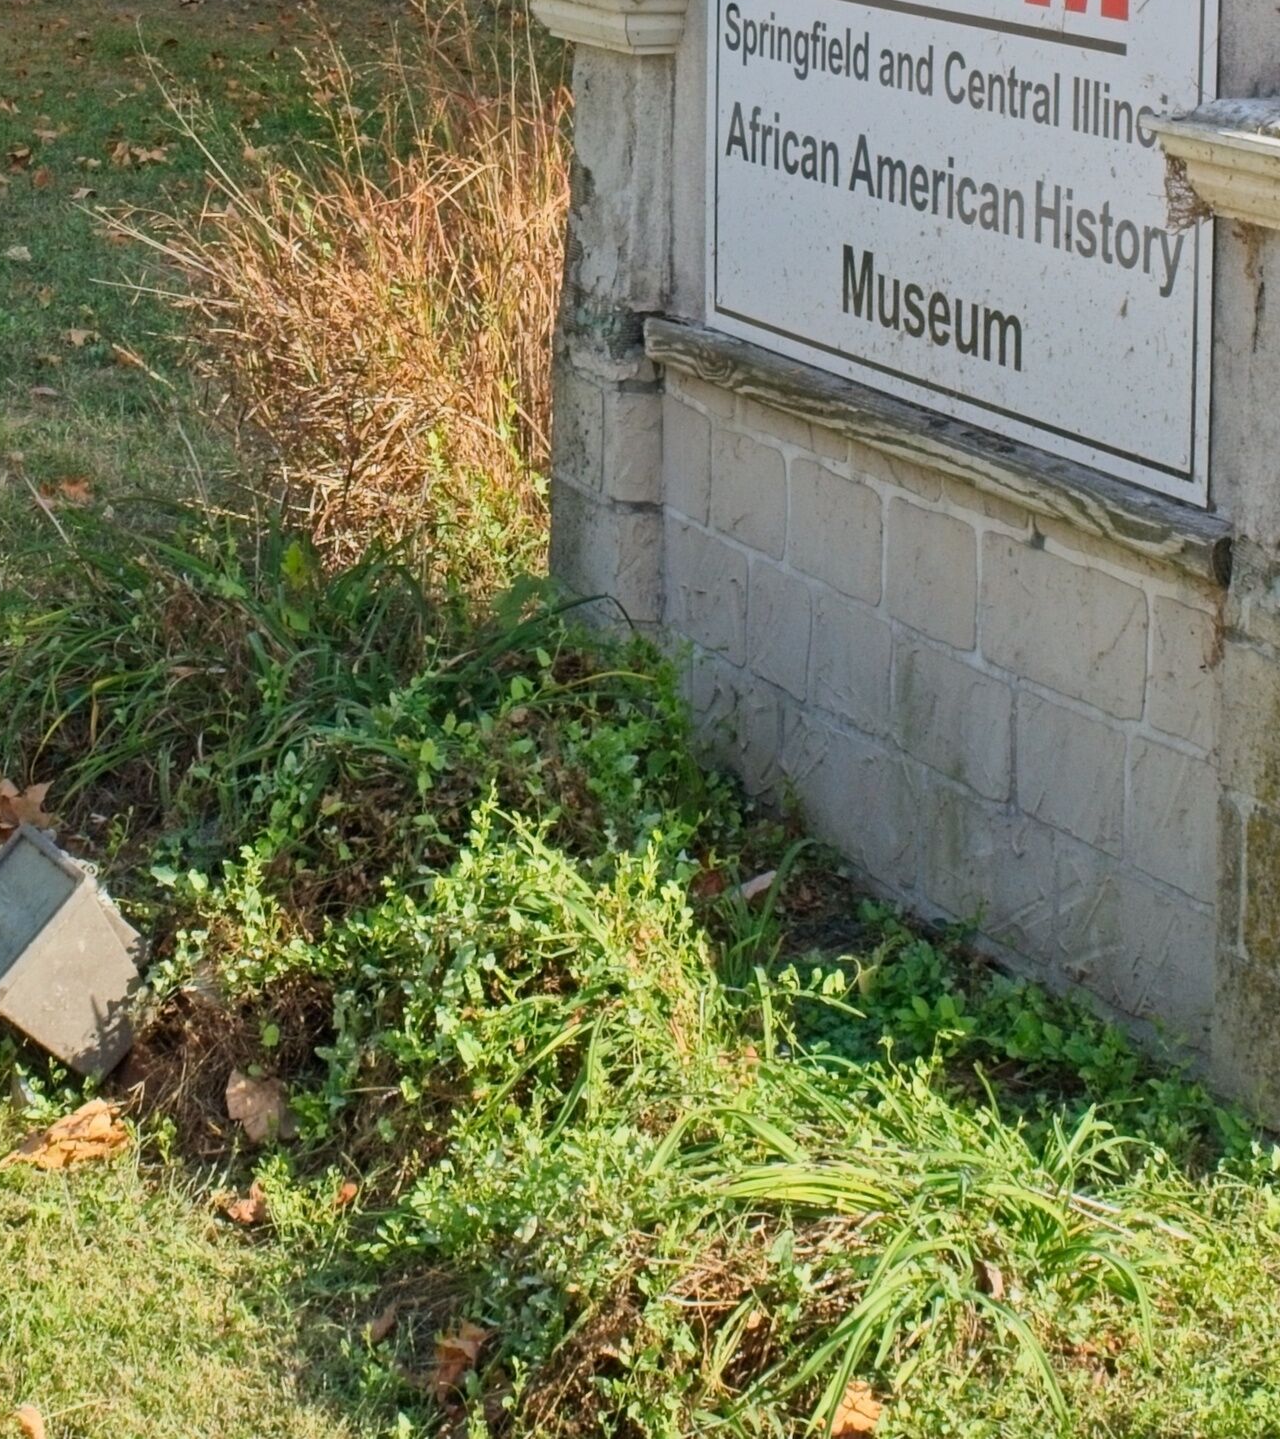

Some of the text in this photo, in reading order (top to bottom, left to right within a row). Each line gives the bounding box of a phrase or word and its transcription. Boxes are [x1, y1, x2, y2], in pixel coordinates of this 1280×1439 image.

[725, 2, 1168, 148] Springfield and Central Illino
[725, 101, 1185, 298] African American History
[842, 243, 1022, 372] Museum
